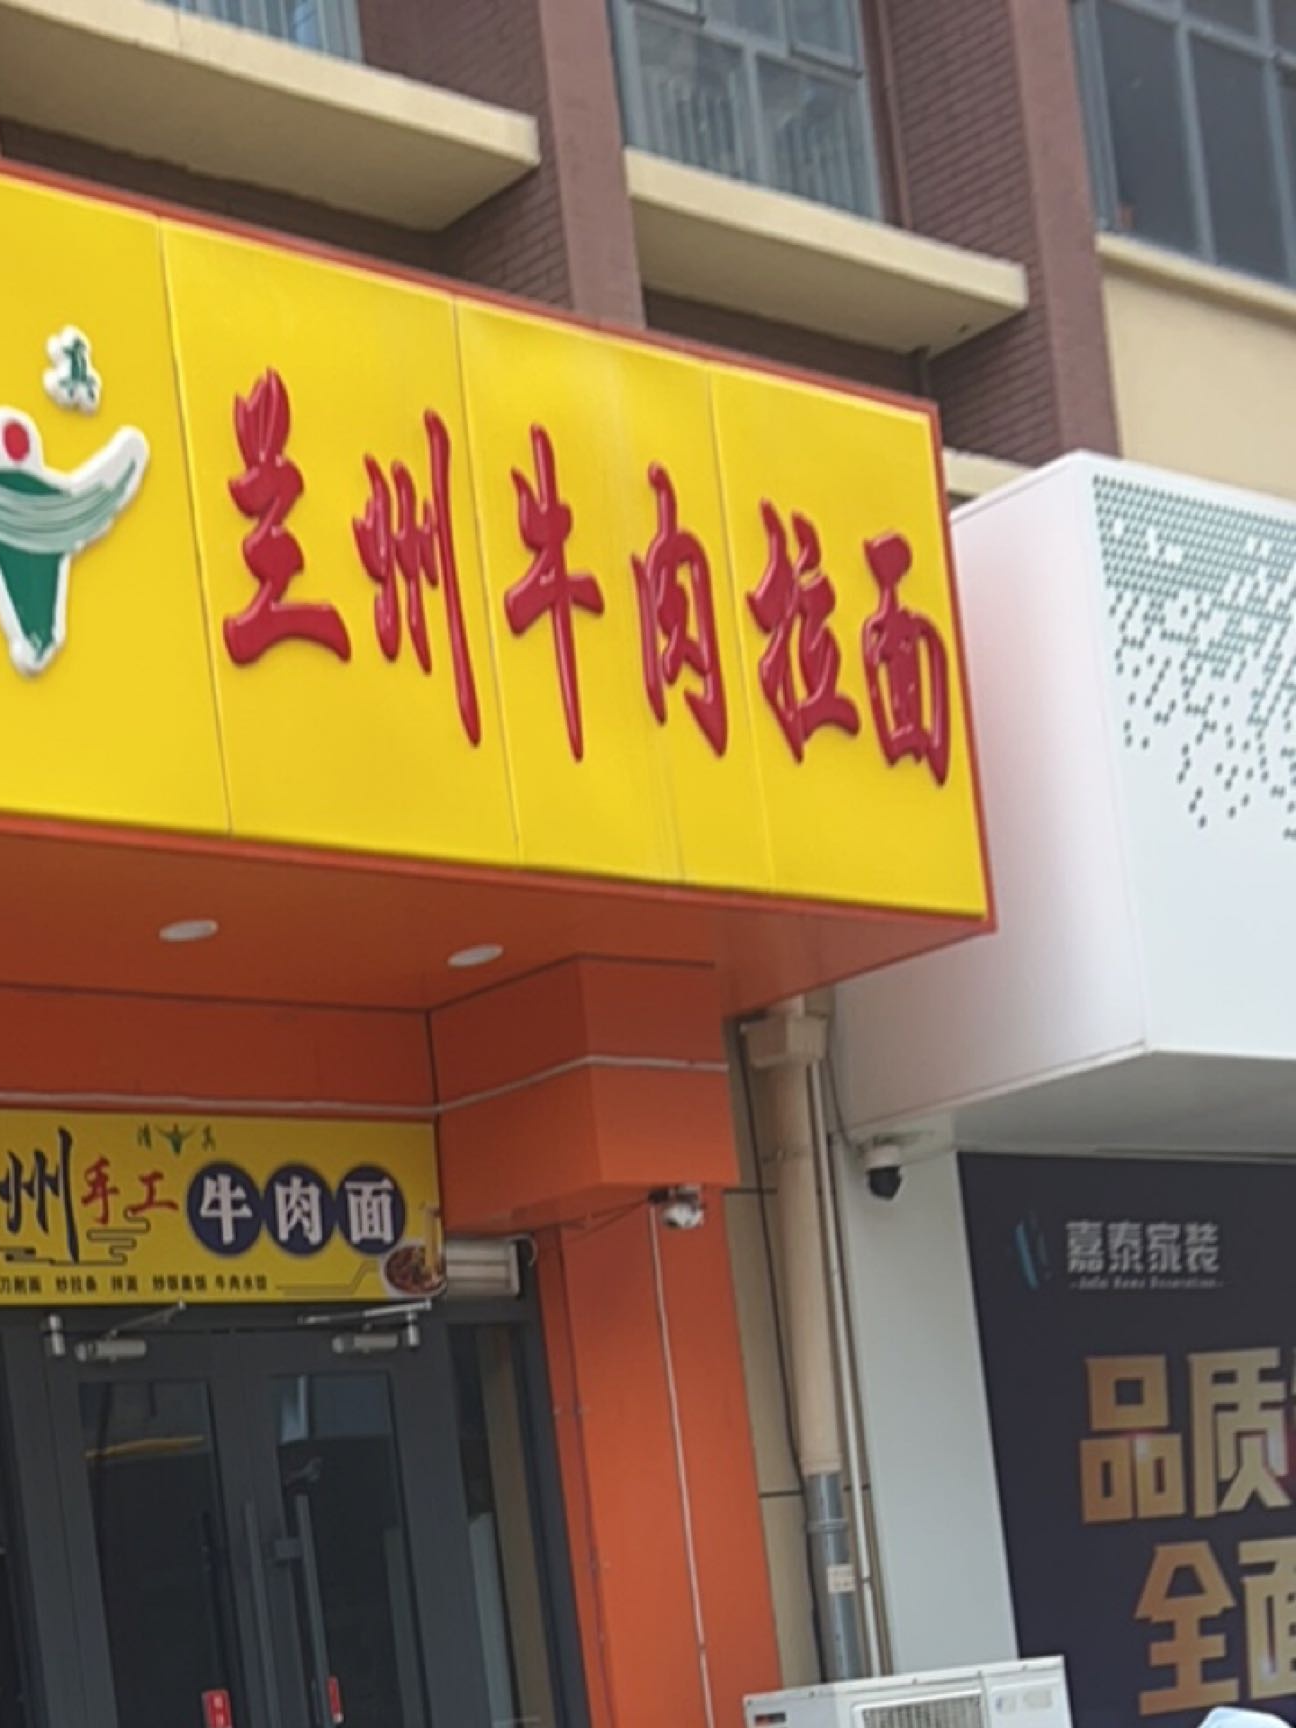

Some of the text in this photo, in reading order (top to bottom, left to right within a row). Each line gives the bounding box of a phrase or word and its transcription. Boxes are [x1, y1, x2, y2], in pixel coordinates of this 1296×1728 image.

[223, 366, 950, 787] 兰州牛肉拉面
[1065, 1219, 1220, 1273] 嘉泰家装
[1080, 1348, 1290, 1524] 品质
